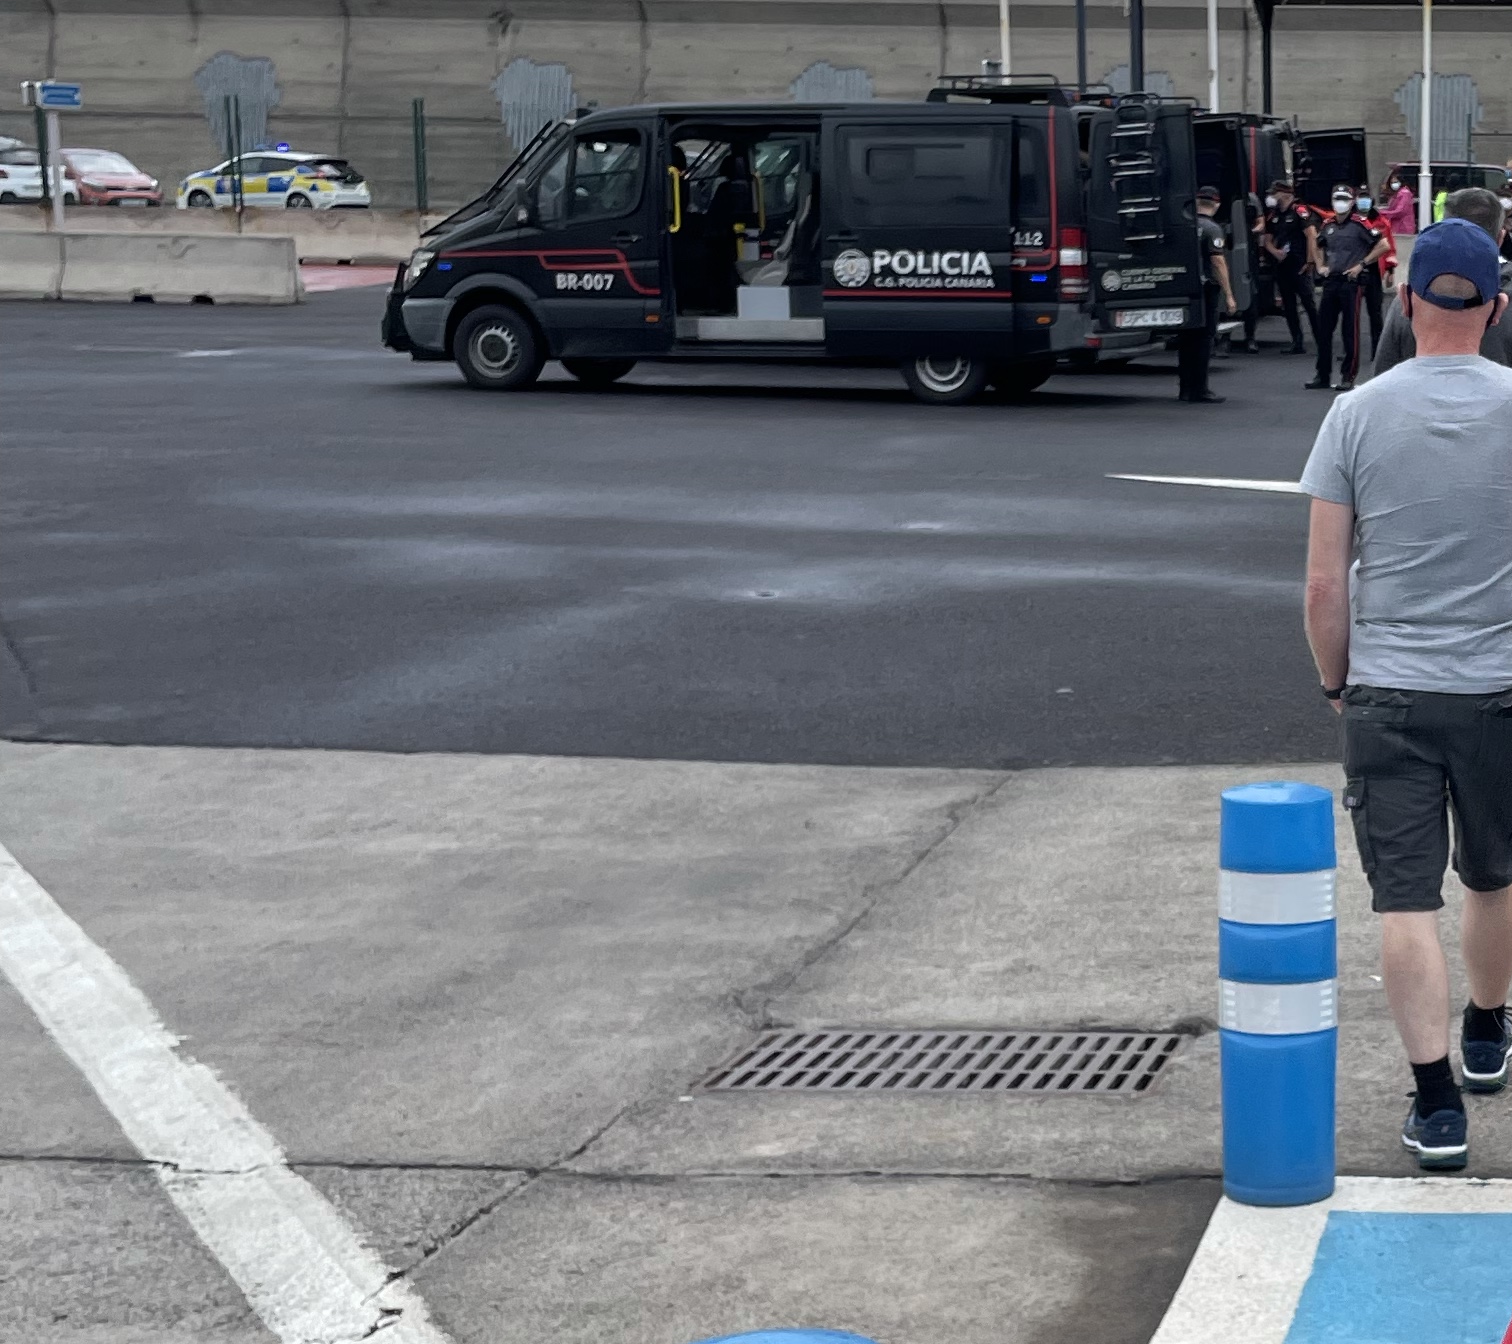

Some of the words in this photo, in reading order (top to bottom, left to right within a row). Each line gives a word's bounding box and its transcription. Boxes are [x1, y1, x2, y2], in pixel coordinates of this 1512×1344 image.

[1013, 231, 1044, 246] 112
[873, 250, 993, 276] POLICIA
[556, 272, 615, 291] BR-007
